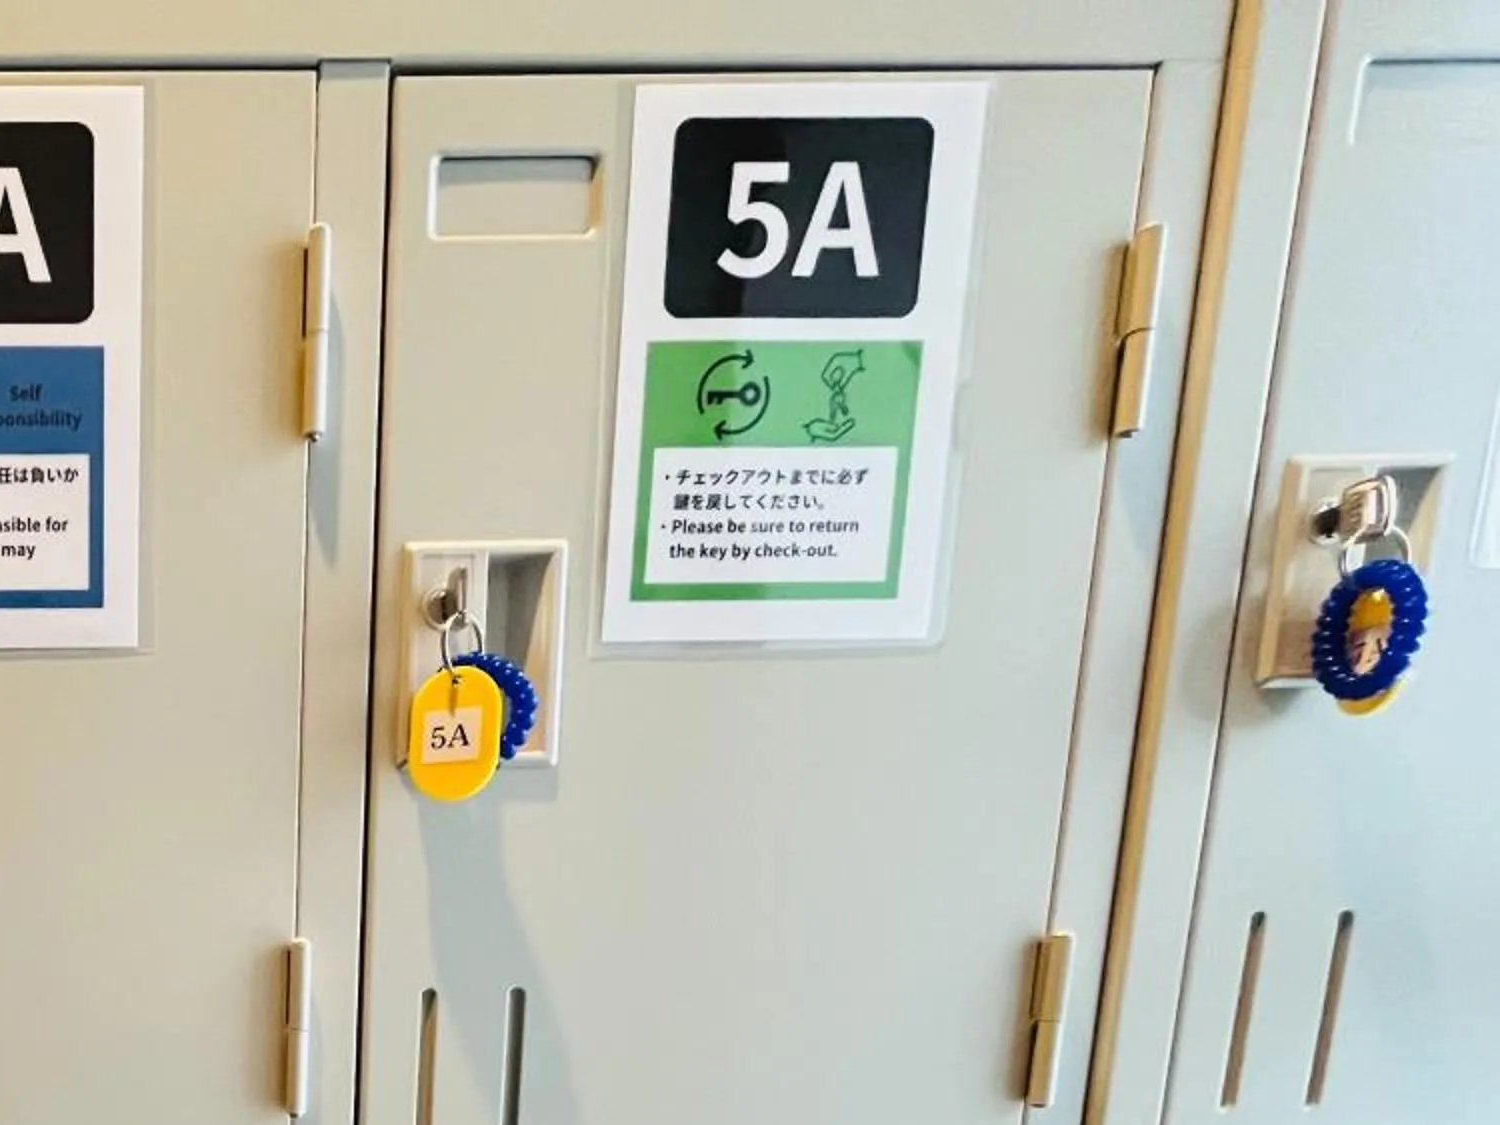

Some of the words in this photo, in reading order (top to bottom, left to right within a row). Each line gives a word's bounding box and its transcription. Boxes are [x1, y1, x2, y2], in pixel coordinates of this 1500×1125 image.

[716, 161, 880, 278] 5A
[9, 384, 43, 401] Self
[45, 516, 68, 532] for
[671, 520, 723, 534] Please
[728, 520, 746, 533] be
[750, 522, 784, 533] sure
[789, 521, 804, 532] to
[809, 521, 859, 532] return
[1, 545, 36, 560] may
[670, 544, 695, 558] the
[700, 544, 727, 560] key
[732, 544, 750, 560] by
[755, 544, 837, 558] check-out.
[431, 724, 470, 749] 5A
